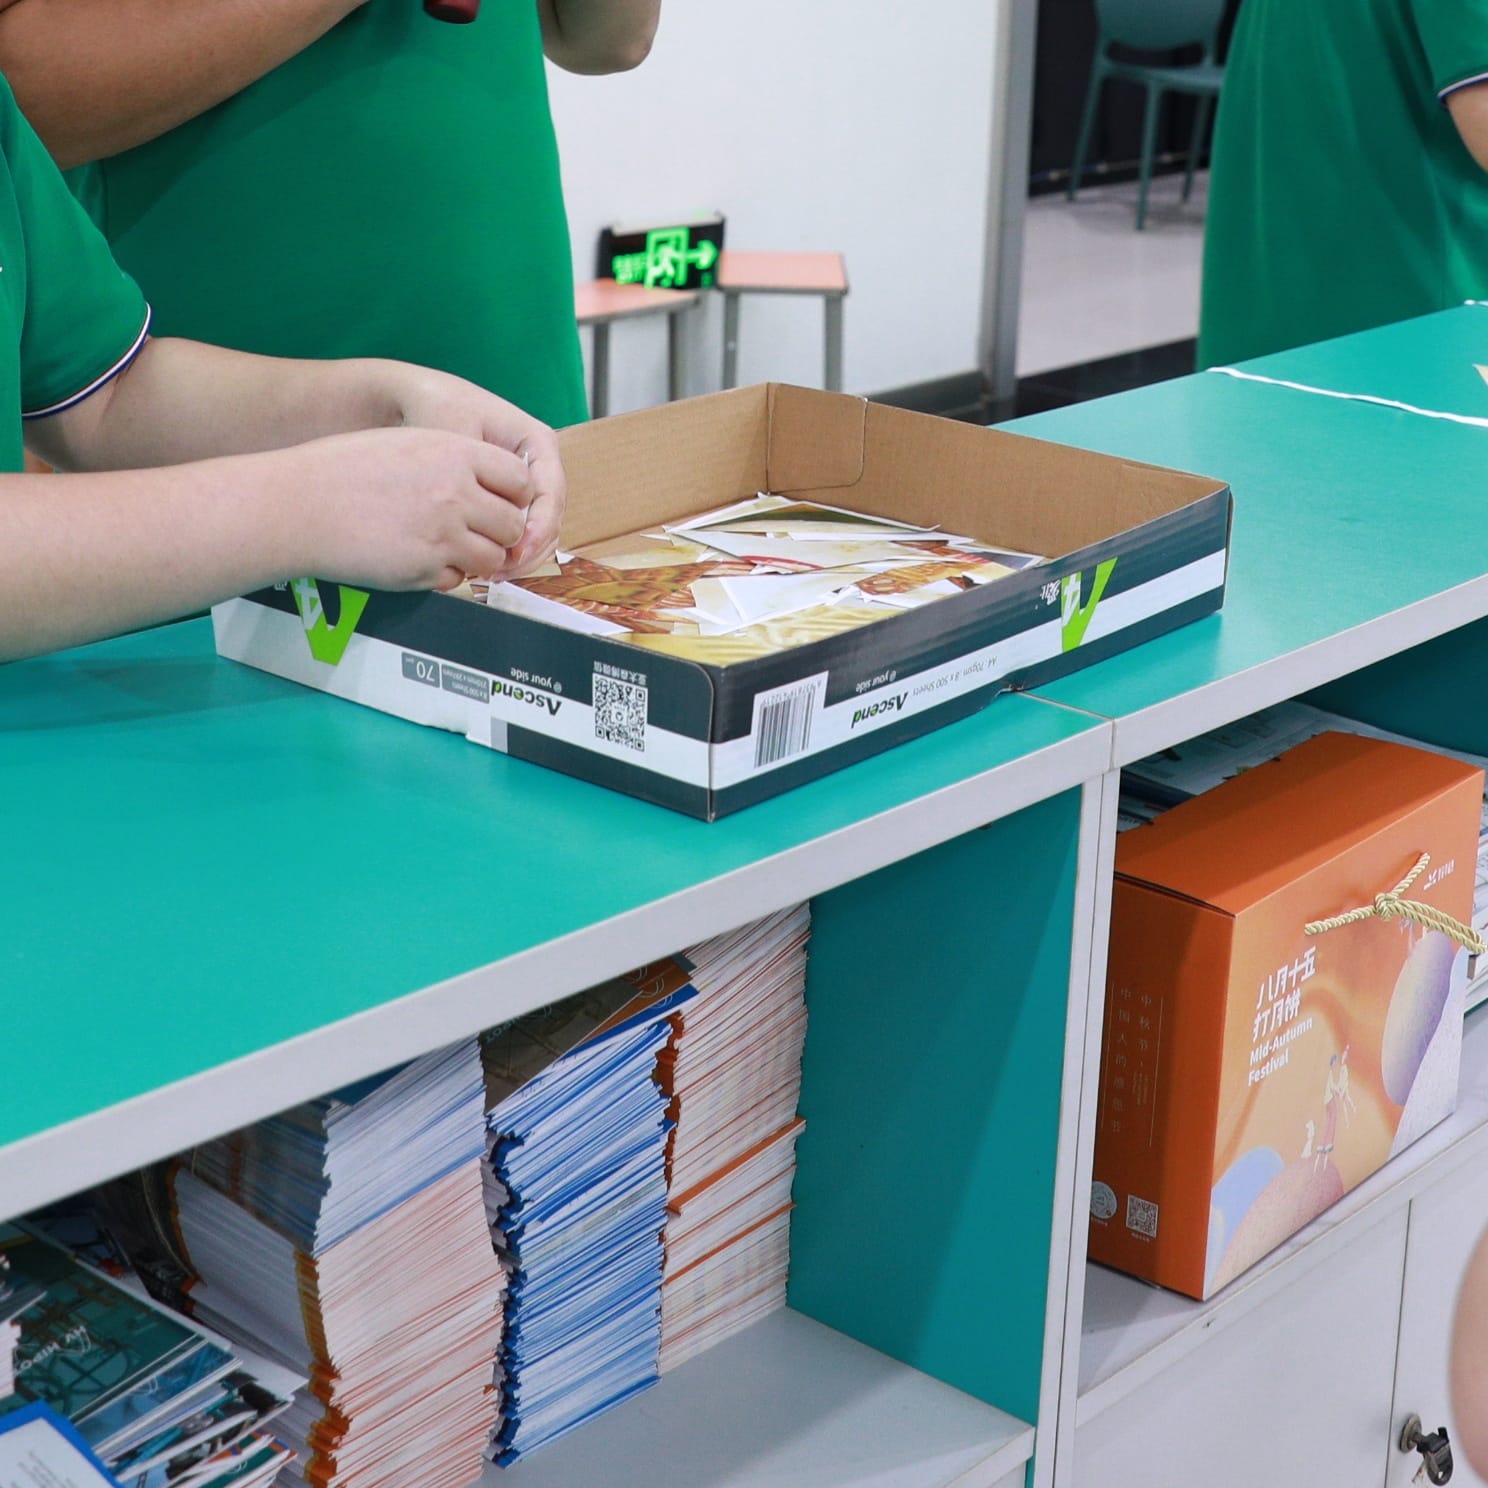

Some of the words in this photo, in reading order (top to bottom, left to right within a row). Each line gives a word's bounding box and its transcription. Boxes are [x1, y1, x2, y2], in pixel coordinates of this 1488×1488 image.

[416, 661, 436, 682] 70
[510, 667, 529, 684] side
[530, 670, 554, 693] your
[856, 679, 871, 693] side
[871, 671, 890, 687] your
[491, 679, 562, 716] Ascend
[851, 692, 909, 728] Ascend
[1256, 945, 1316, 1010] 八月十五
[1253, 988, 1300, 1043] 打月饼
[1250, 1017, 1313, 1066] Mid-Autumn
[1248, 1047, 1289, 1087] Festival
